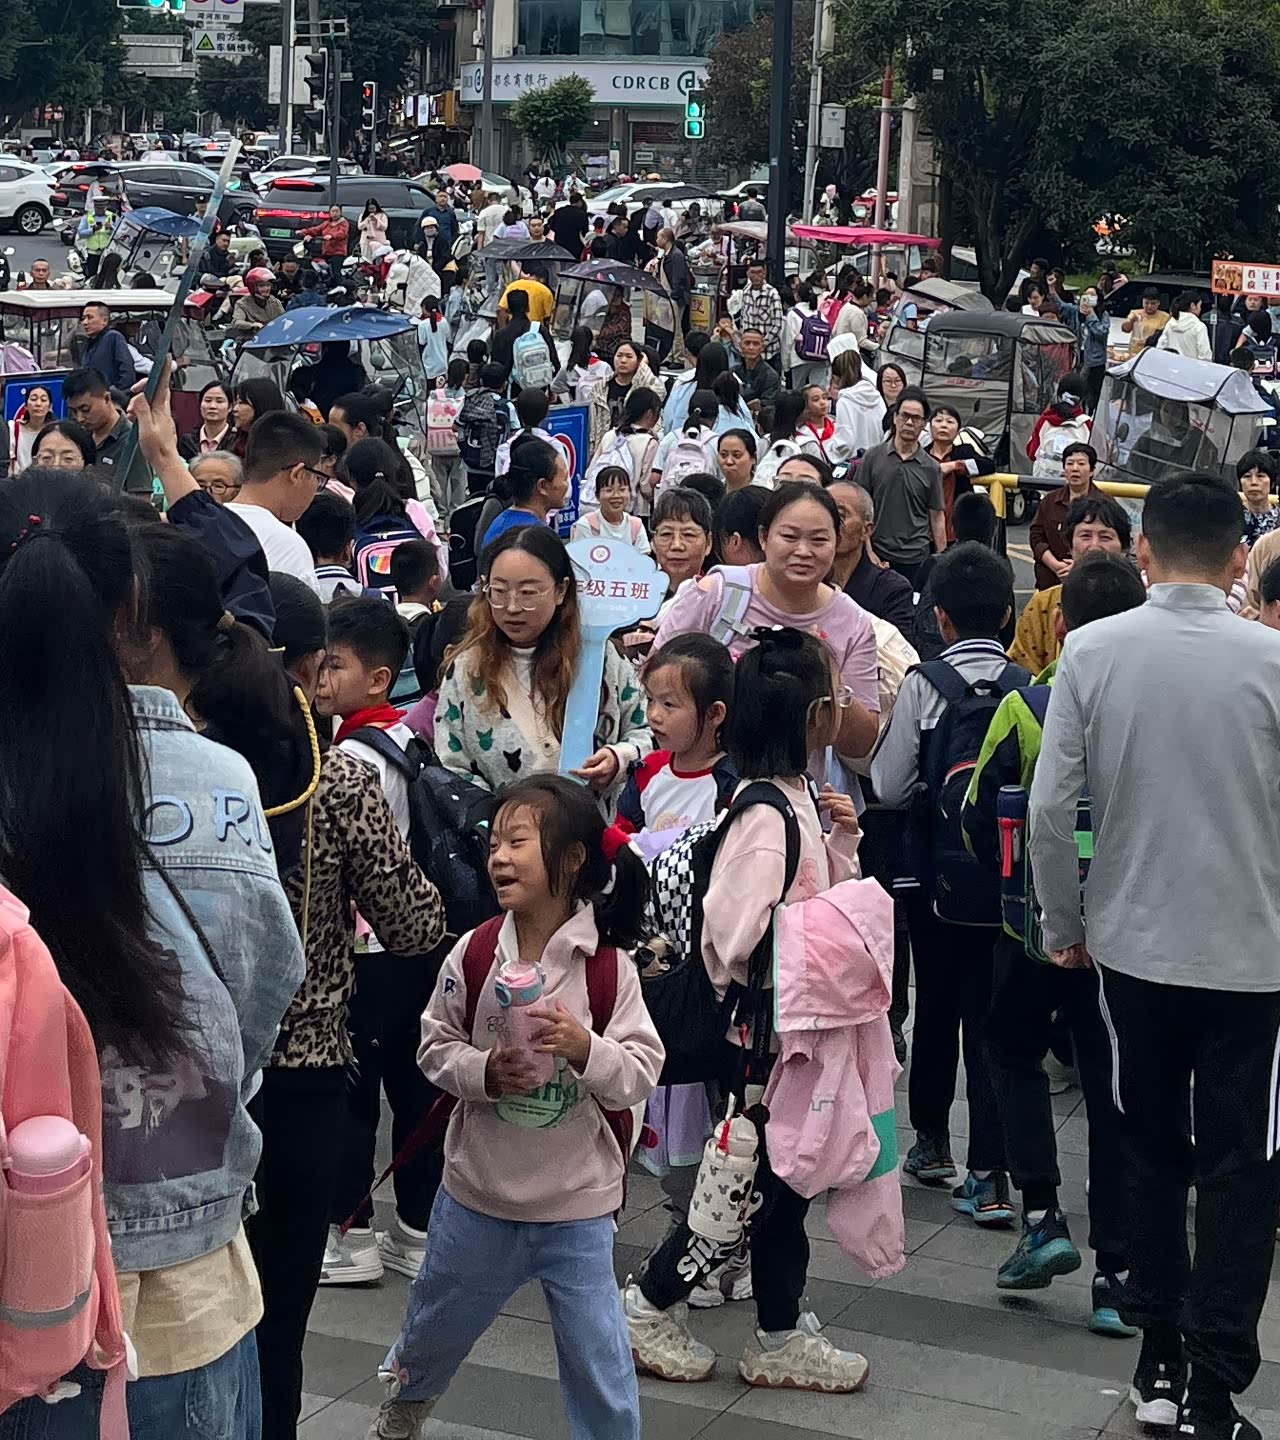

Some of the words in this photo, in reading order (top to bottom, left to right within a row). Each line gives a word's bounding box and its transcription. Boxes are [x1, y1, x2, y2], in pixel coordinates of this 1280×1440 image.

[483, 72, 548, 88] 都农商银行
[612, 75, 671, 91] CDRCB
